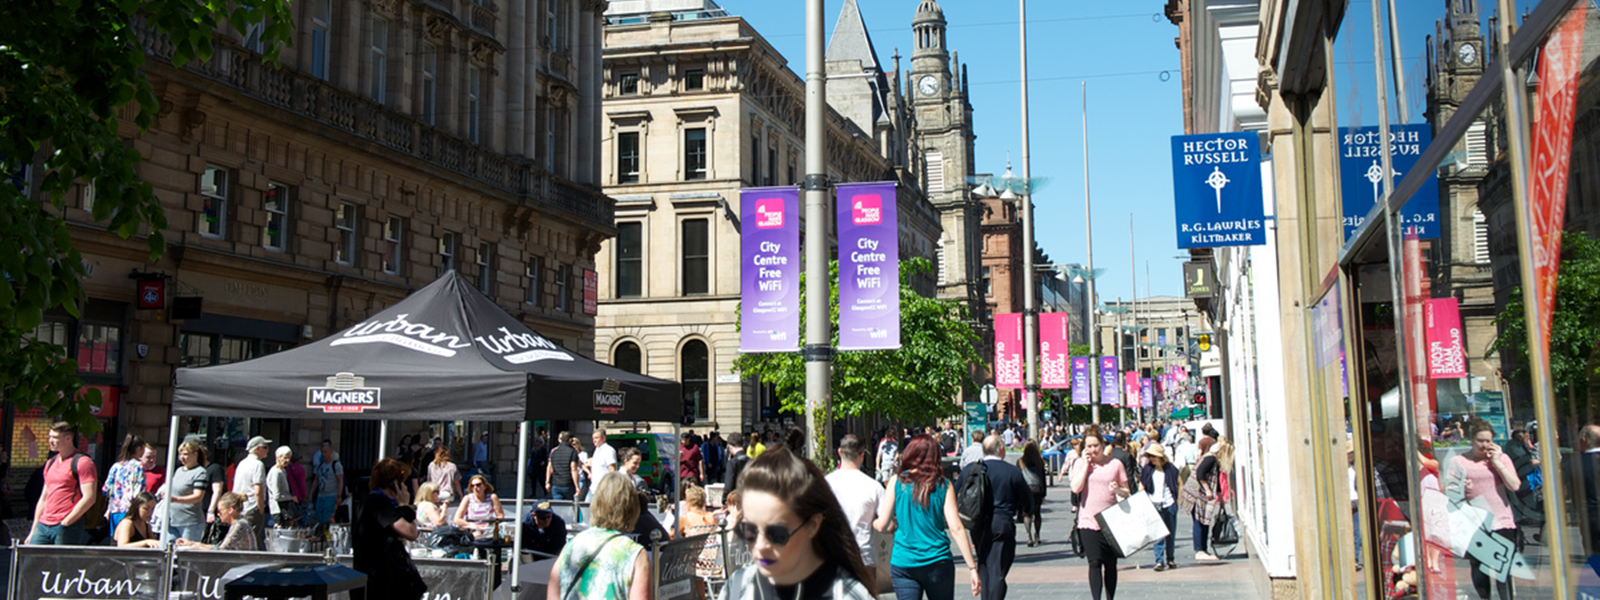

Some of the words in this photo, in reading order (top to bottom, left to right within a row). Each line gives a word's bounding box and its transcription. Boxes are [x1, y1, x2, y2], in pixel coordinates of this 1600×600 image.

[1183, 138, 1248, 153] HECTOR
[1184, 151, 1249, 165] RUSSELL
[857, 238, 879, 251] City
[1191, 233, 1252, 243] KILTMAKER
[760, 241, 781, 254] City
[753, 254, 787, 266] Centre
[851, 251, 886, 263] Centre
[759, 267, 782, 278] Free
[857, 264, 881, 276] Free
[758, 279, 782, 291] WiFi
[856, 277, 881, 289] WiFi
[343, 313, 471, 349] Urban
[474, 326, 557, 354] Urban
[996, 341, 1005, 384] GLASGOW
[1011, 354, 1020, 384] PEOPLE
[1041, 341, 1050, 384] GLASGOW
[1056, 353, 1065, 384] PEOPLE
[1004, 360, 1012, 384] MAKE
[1050, 360, 1058, 384] MAKE
[312, 390, 374, 405] MAGNERS
[595, 392, 623, 406] MAGNERS
[41, 569, 141, 595] Urban
